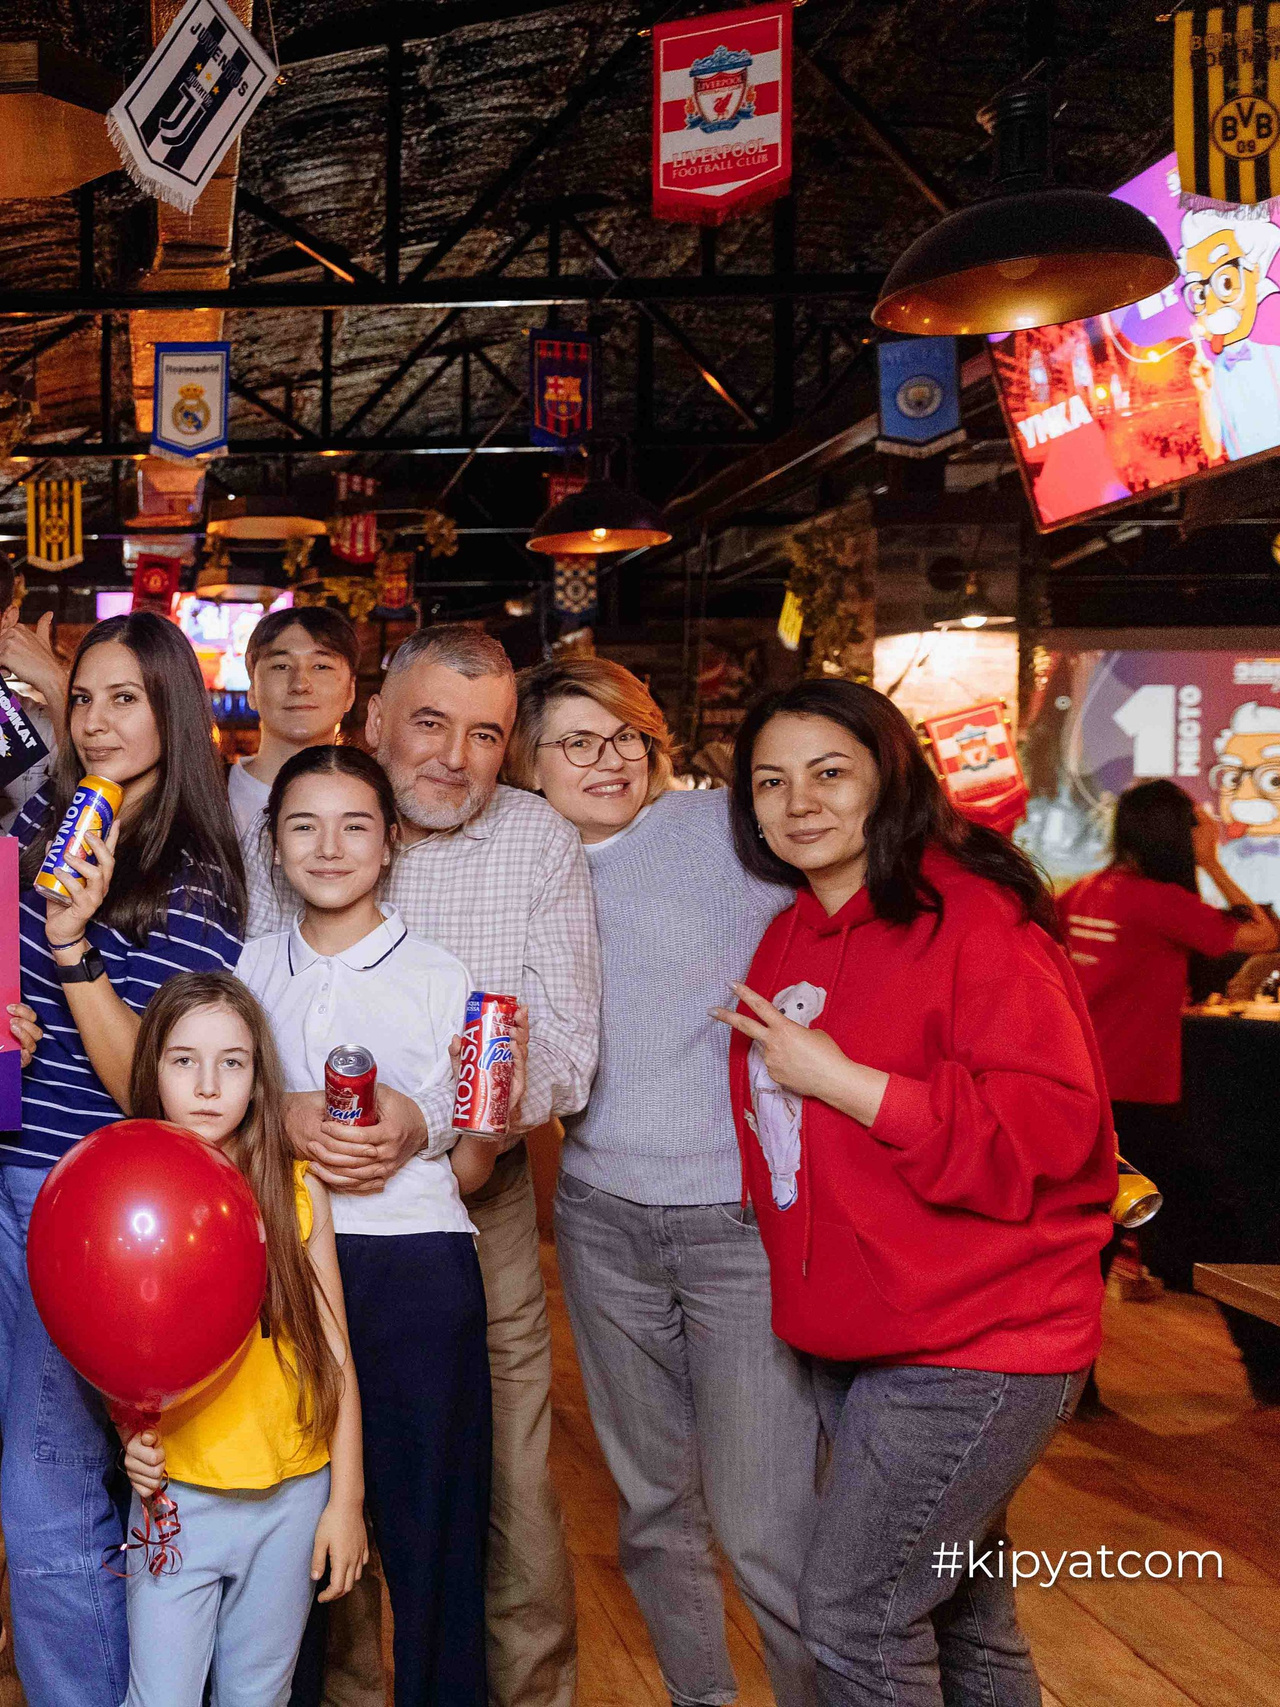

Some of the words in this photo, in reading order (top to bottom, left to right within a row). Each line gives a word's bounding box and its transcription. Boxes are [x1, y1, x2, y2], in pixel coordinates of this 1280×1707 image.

[671, 137, 769, 169] LIVERPOOL
[672, 159, 734, 180] FOOTBALL
[736, 154, 769, 169] CLUB
[1113, 684, 1176, 777] 1
[44, 791, 87, 869] DONAVI
[454, 1025, 480, 1120] ROSSA
